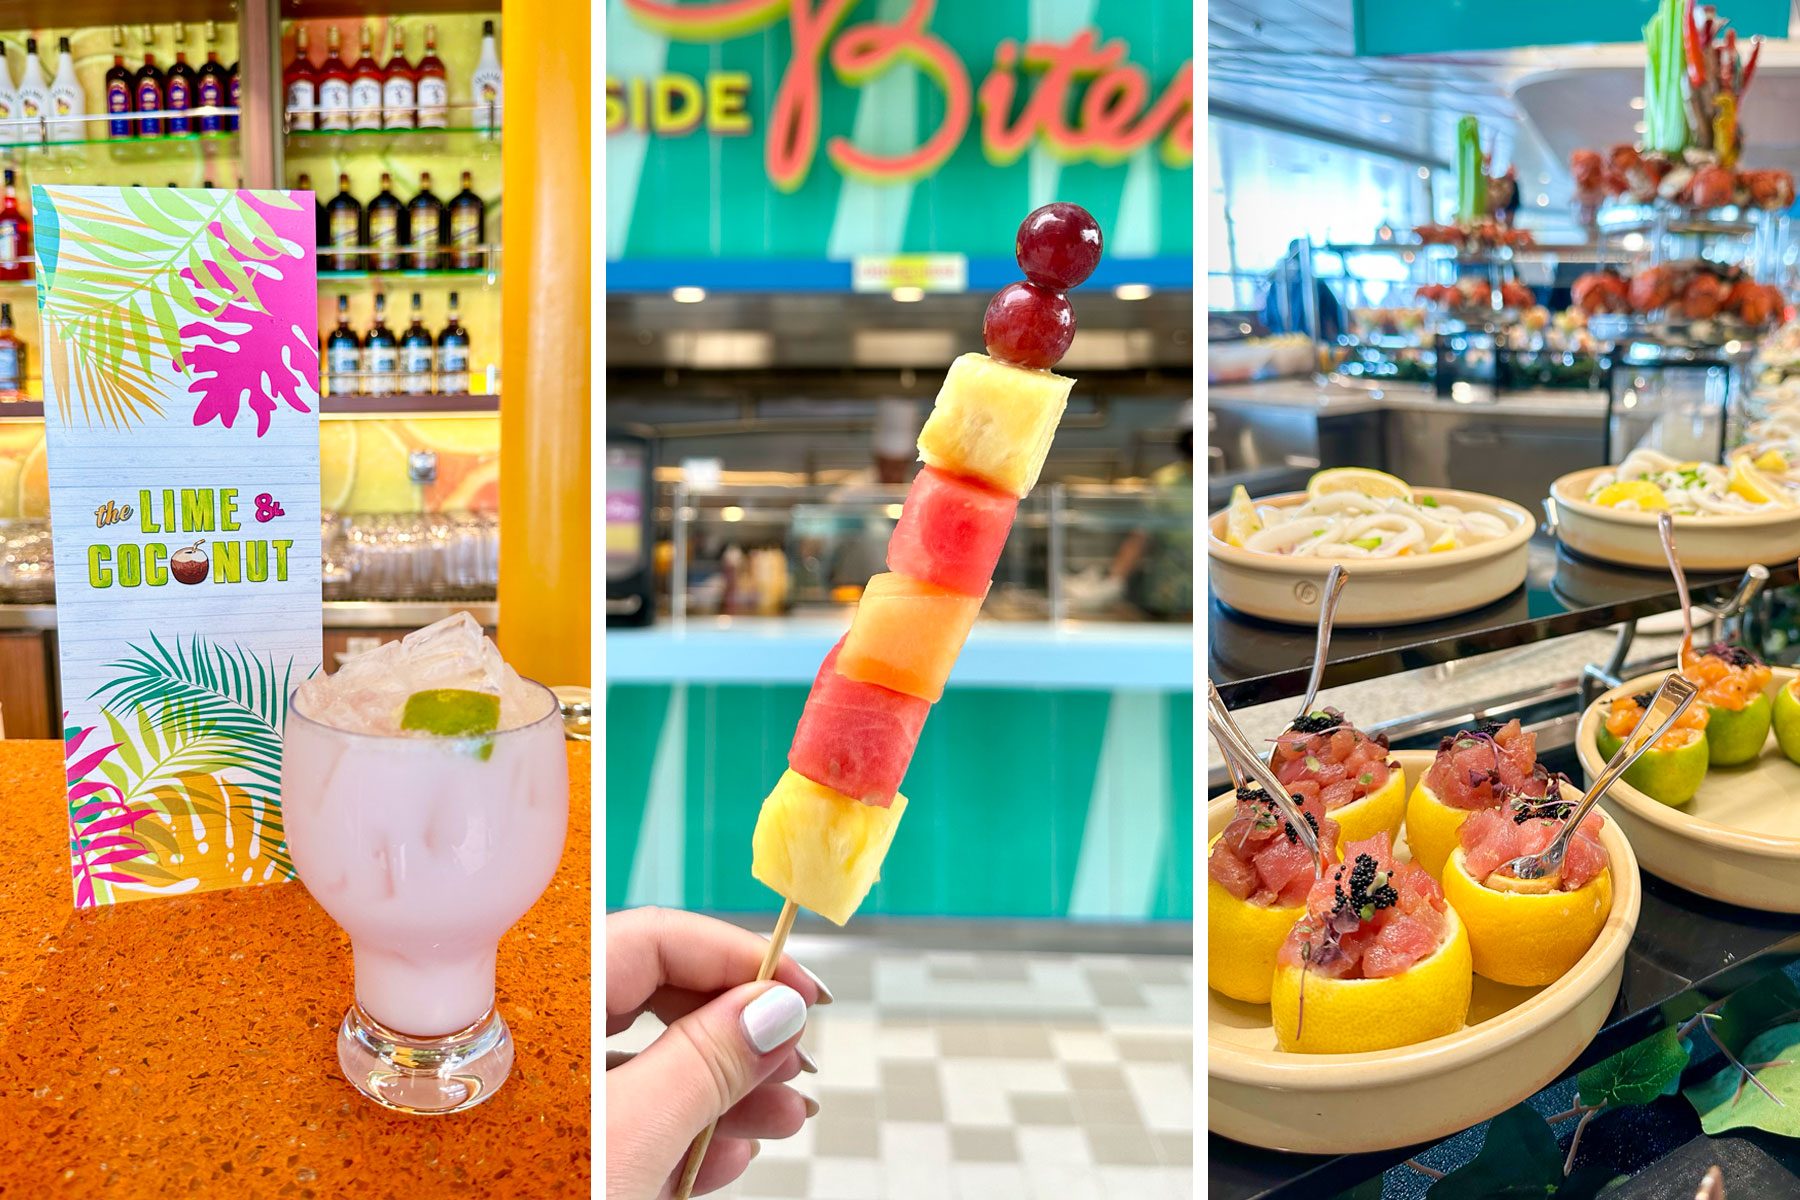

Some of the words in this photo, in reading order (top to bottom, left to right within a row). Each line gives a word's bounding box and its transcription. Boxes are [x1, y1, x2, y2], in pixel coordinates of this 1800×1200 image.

[94, 499, 134, 529] the
[139, 488, 241, 533] LIME
[254, 492, 286, 524] &
[88, 539, 294, 588] COCONUT
